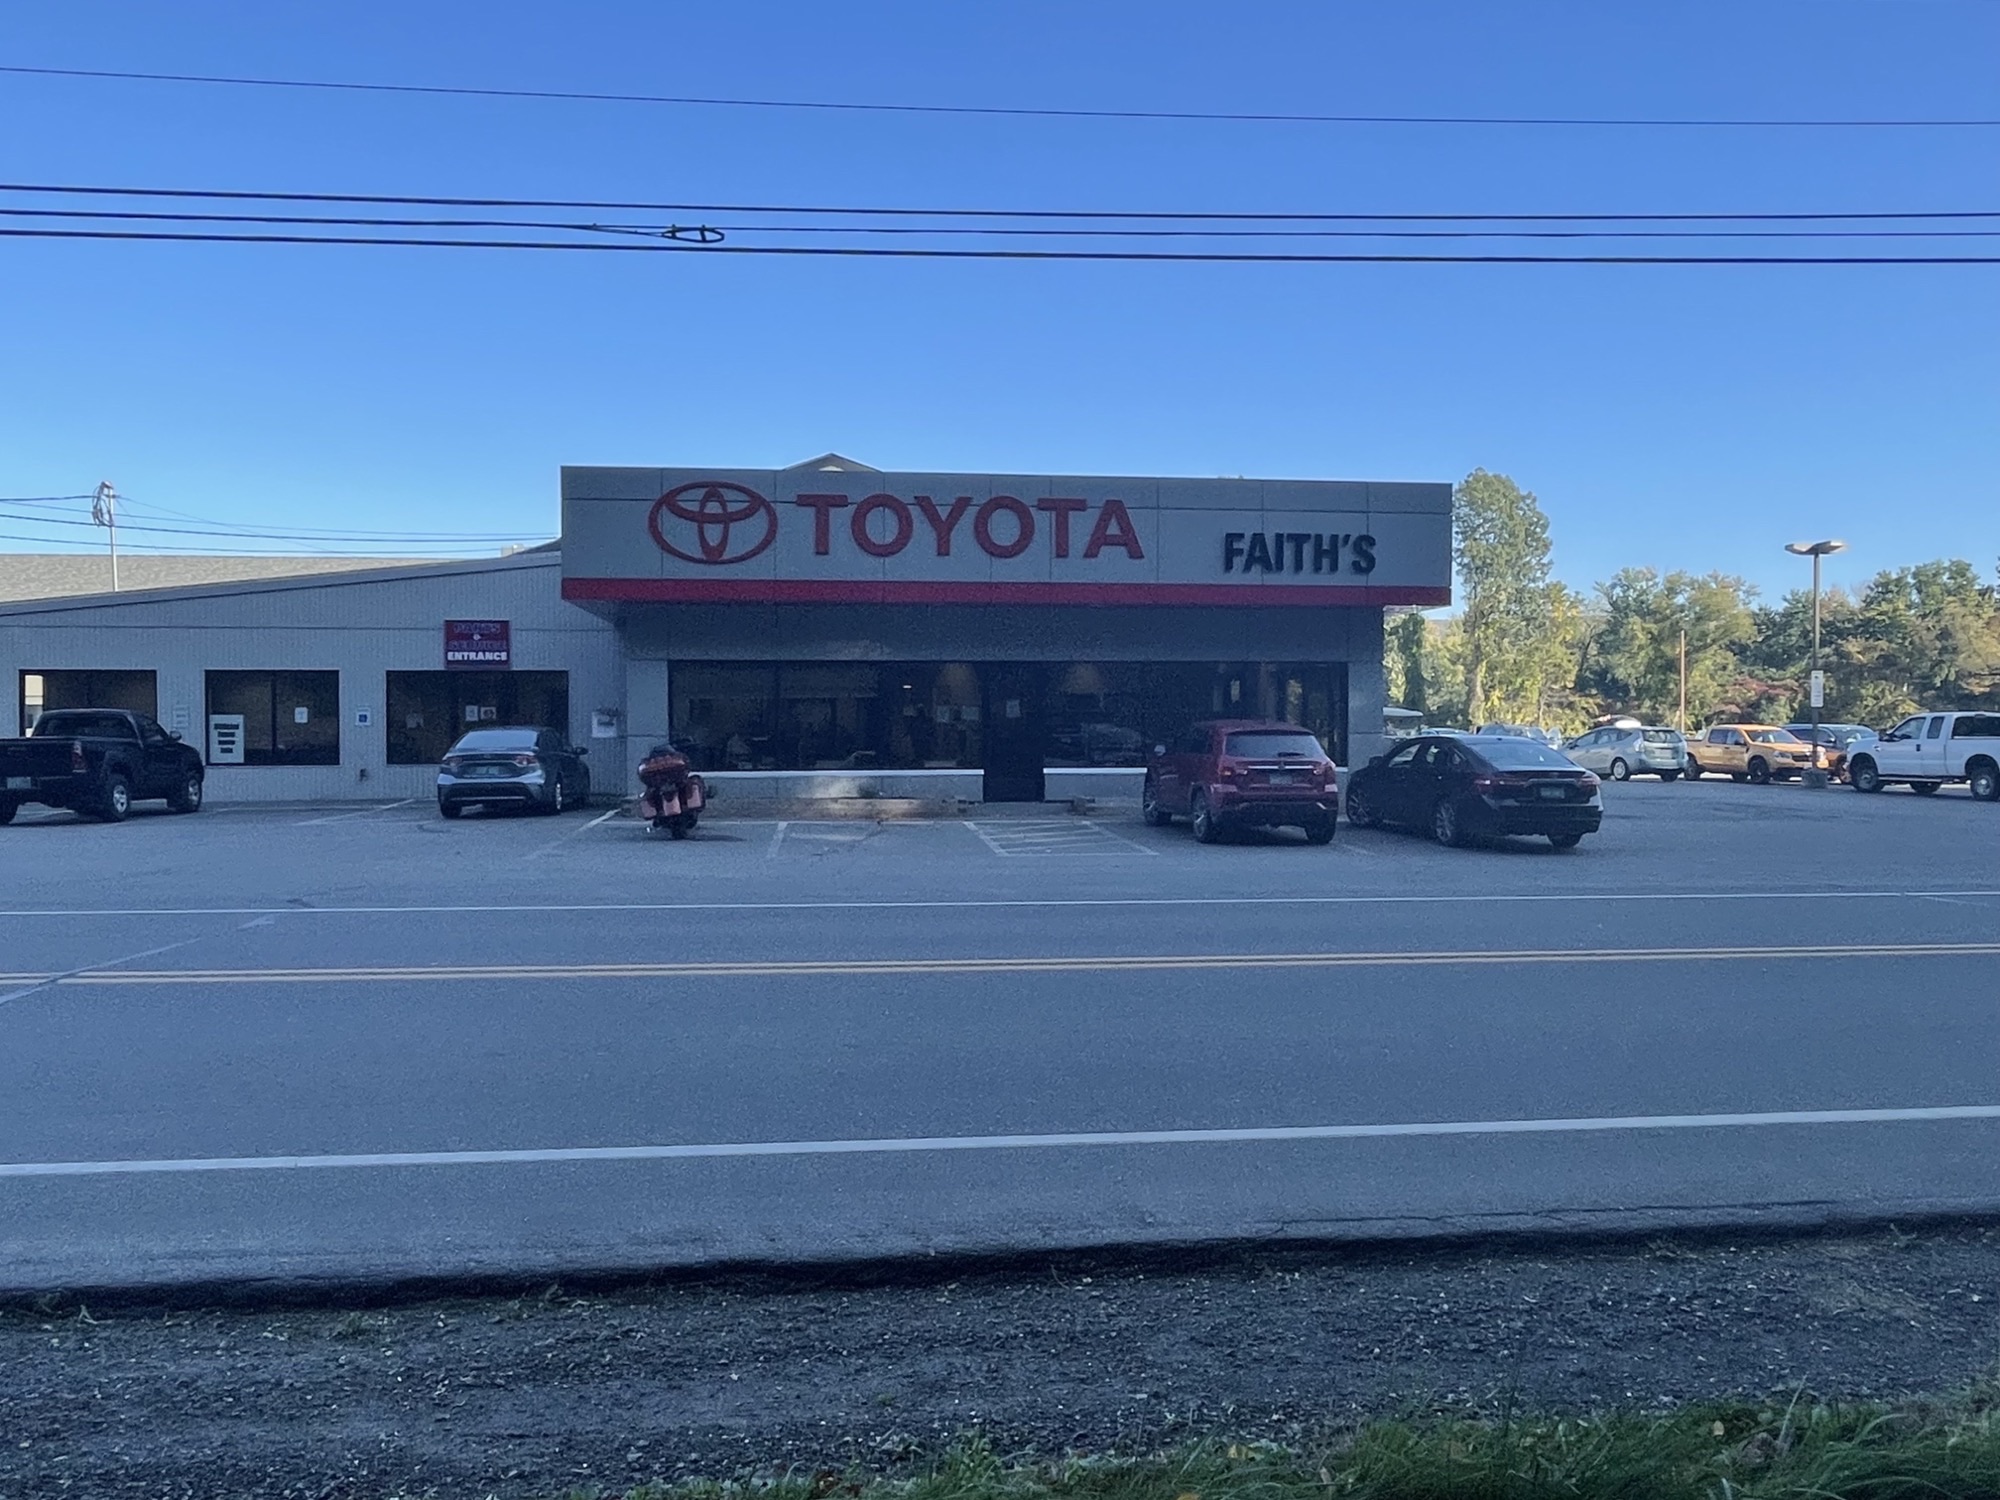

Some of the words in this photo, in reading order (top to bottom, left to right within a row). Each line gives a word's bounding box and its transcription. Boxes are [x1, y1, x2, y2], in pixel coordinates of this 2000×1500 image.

[797, 494, 1144, 559] TOYOTA
[1223, 532, 1376, 574] FAITH'S
[447, 651, 508, 661] ENTRANCE
